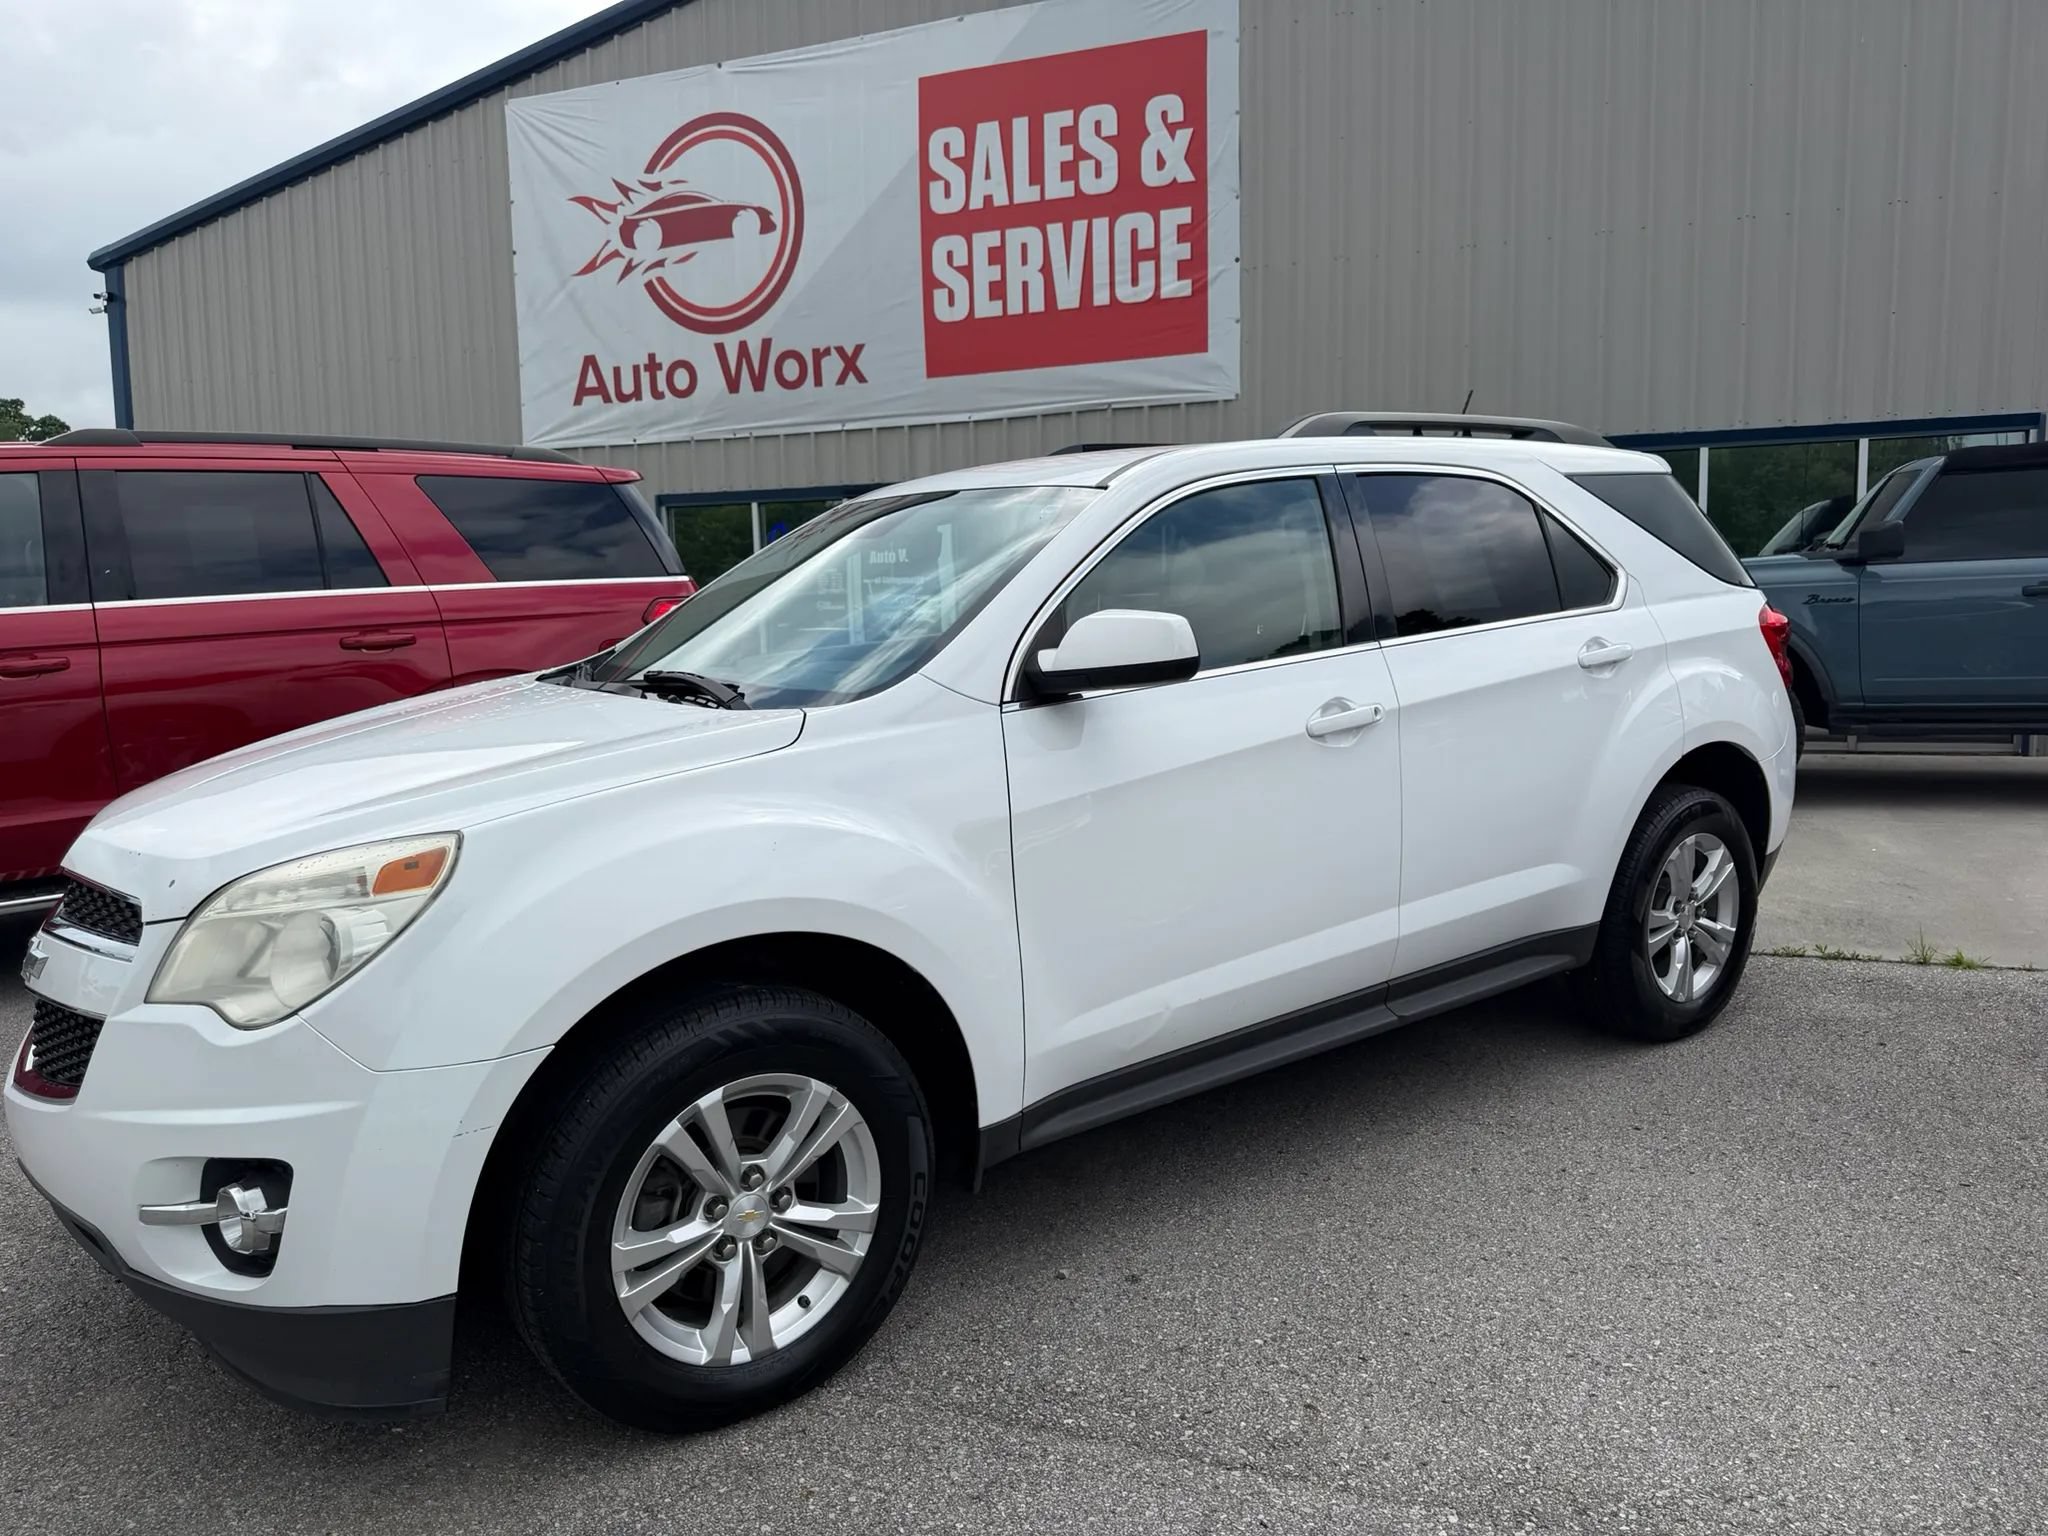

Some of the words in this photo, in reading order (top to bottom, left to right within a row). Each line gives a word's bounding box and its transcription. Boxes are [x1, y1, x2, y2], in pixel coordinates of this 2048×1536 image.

[928, 104, 1119, 215] SALES
[1140, 94, 1196, 188] &
[932, 206, 1193, 324] SERVICE
[573, 353, 699, 407] Auto
[713, 337, 869, 395] Worx
